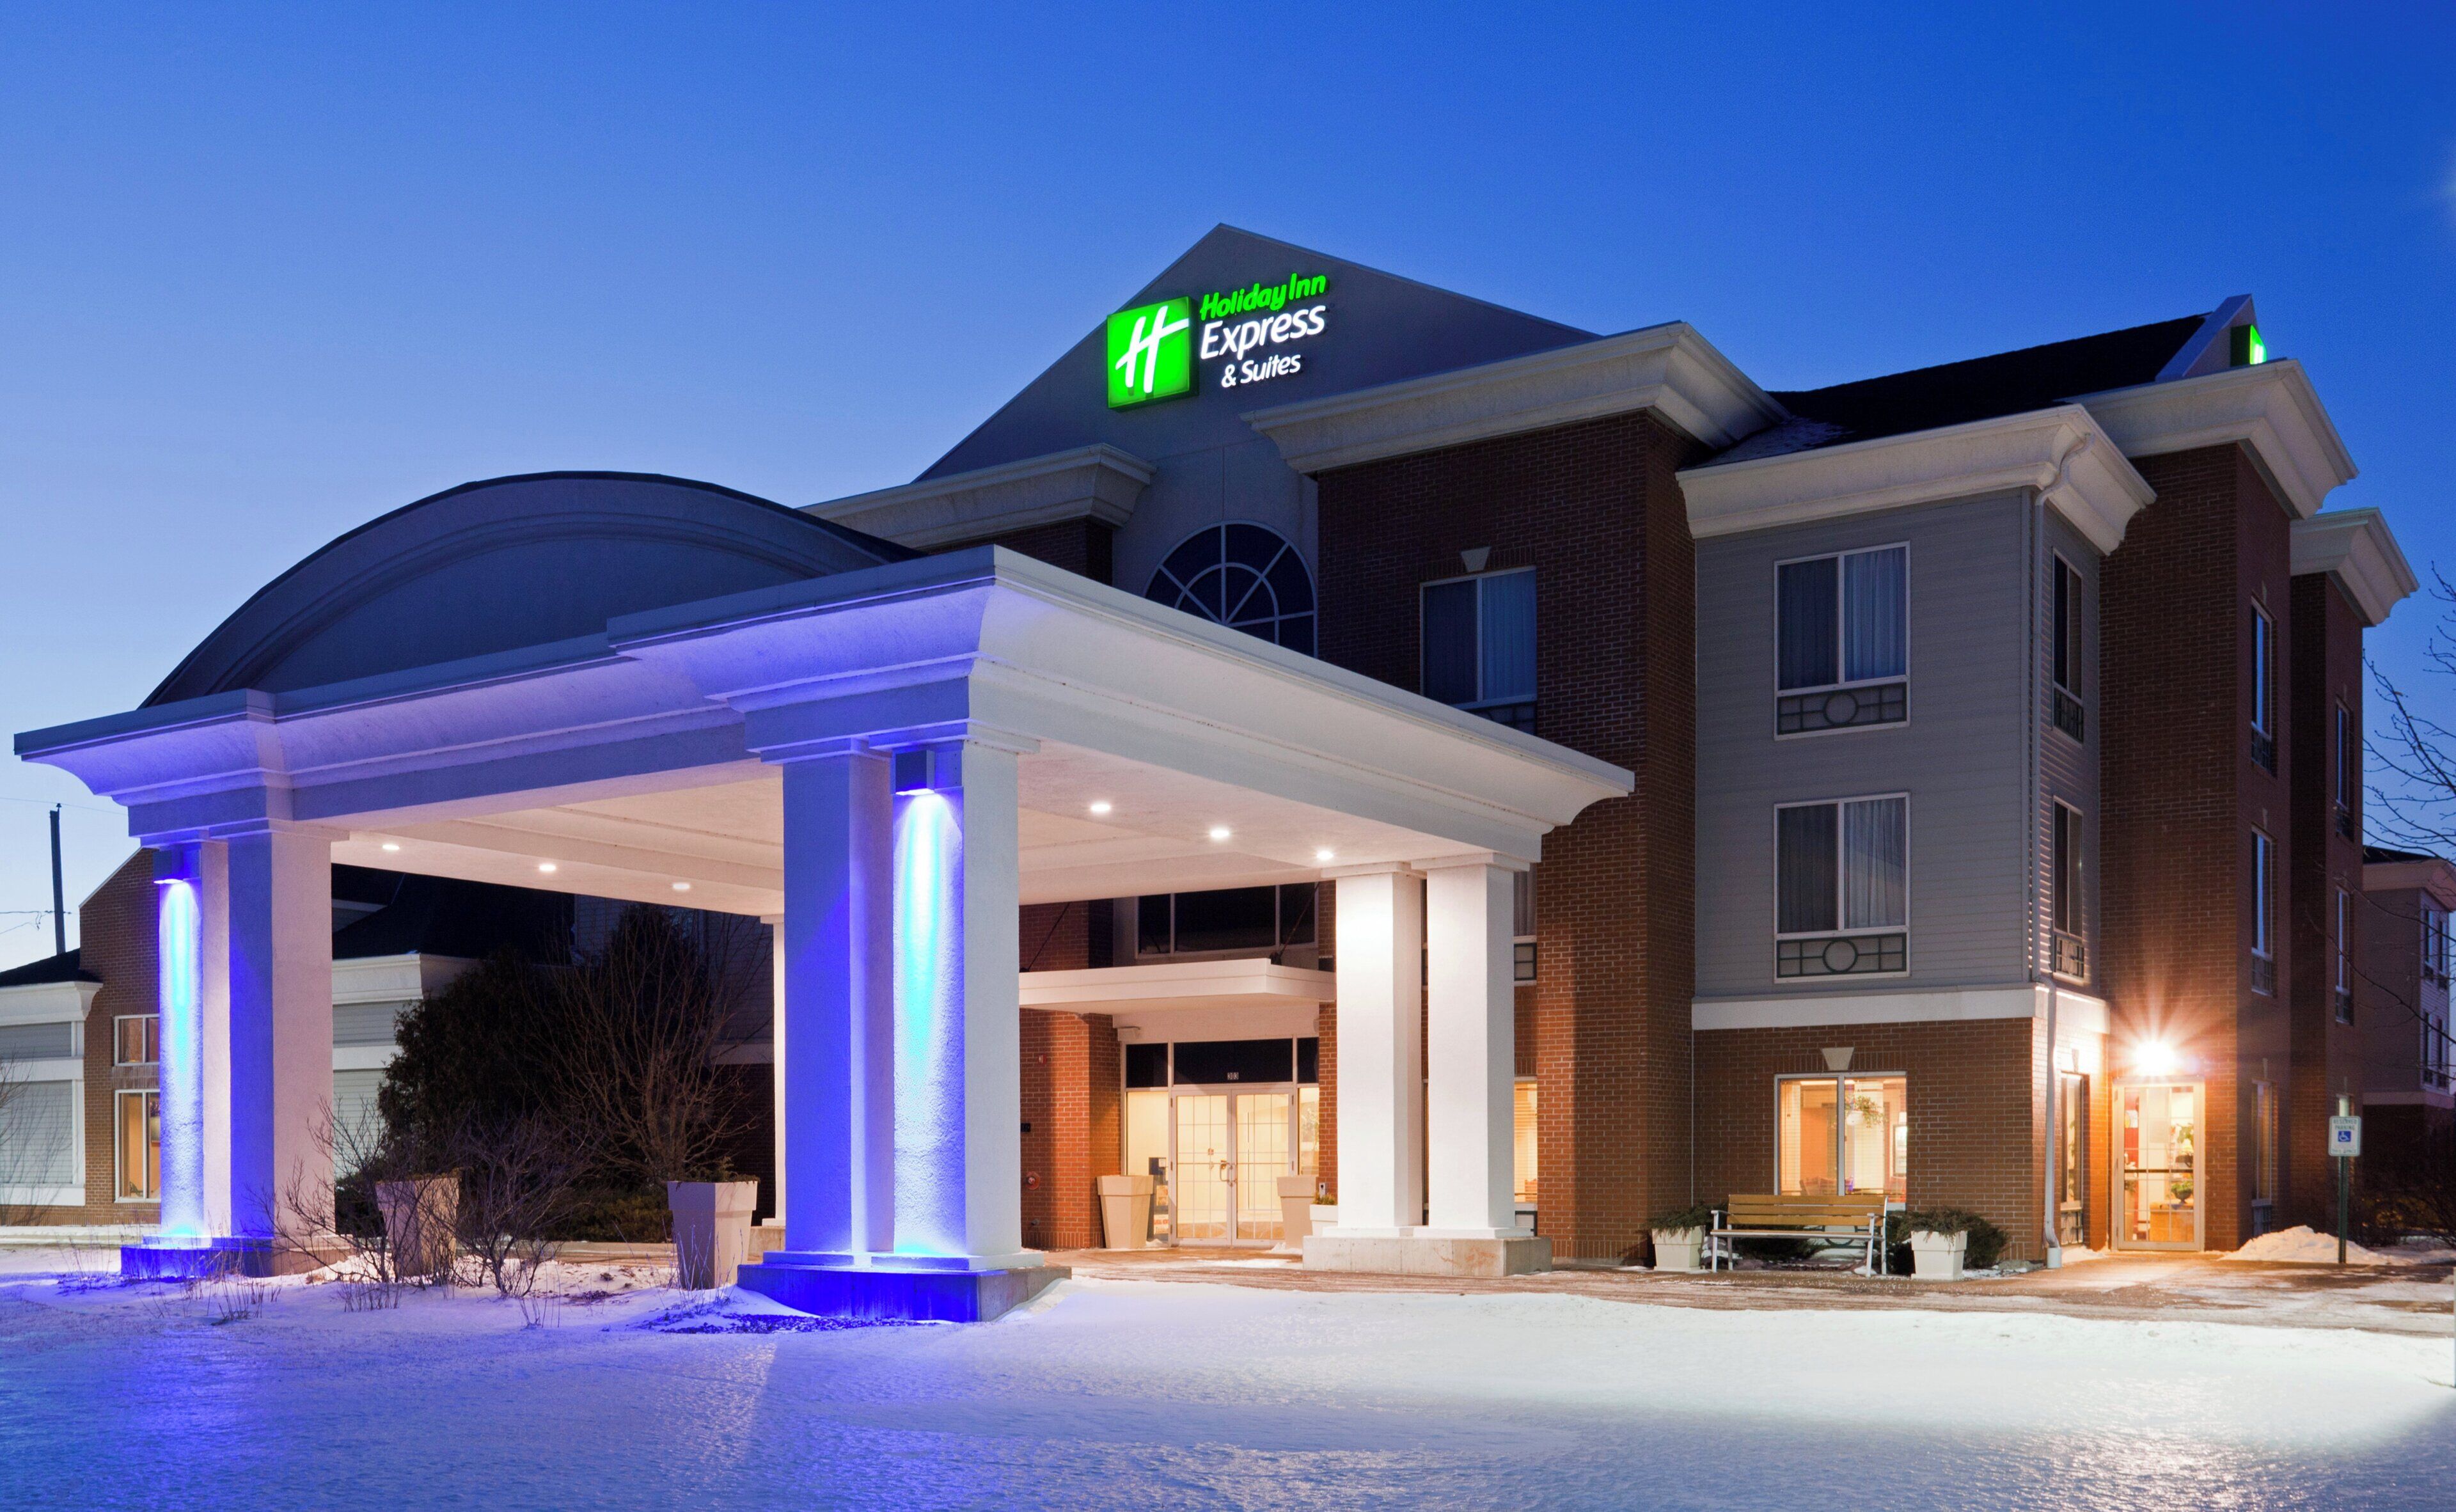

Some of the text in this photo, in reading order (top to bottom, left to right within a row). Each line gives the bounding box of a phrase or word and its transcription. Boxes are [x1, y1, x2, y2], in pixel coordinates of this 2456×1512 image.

[1200, 273, 1326, 320] Holiday Inn
[1200, 305, 1326, 359] Express
[1222, 354, 1301, 388] & Suites
